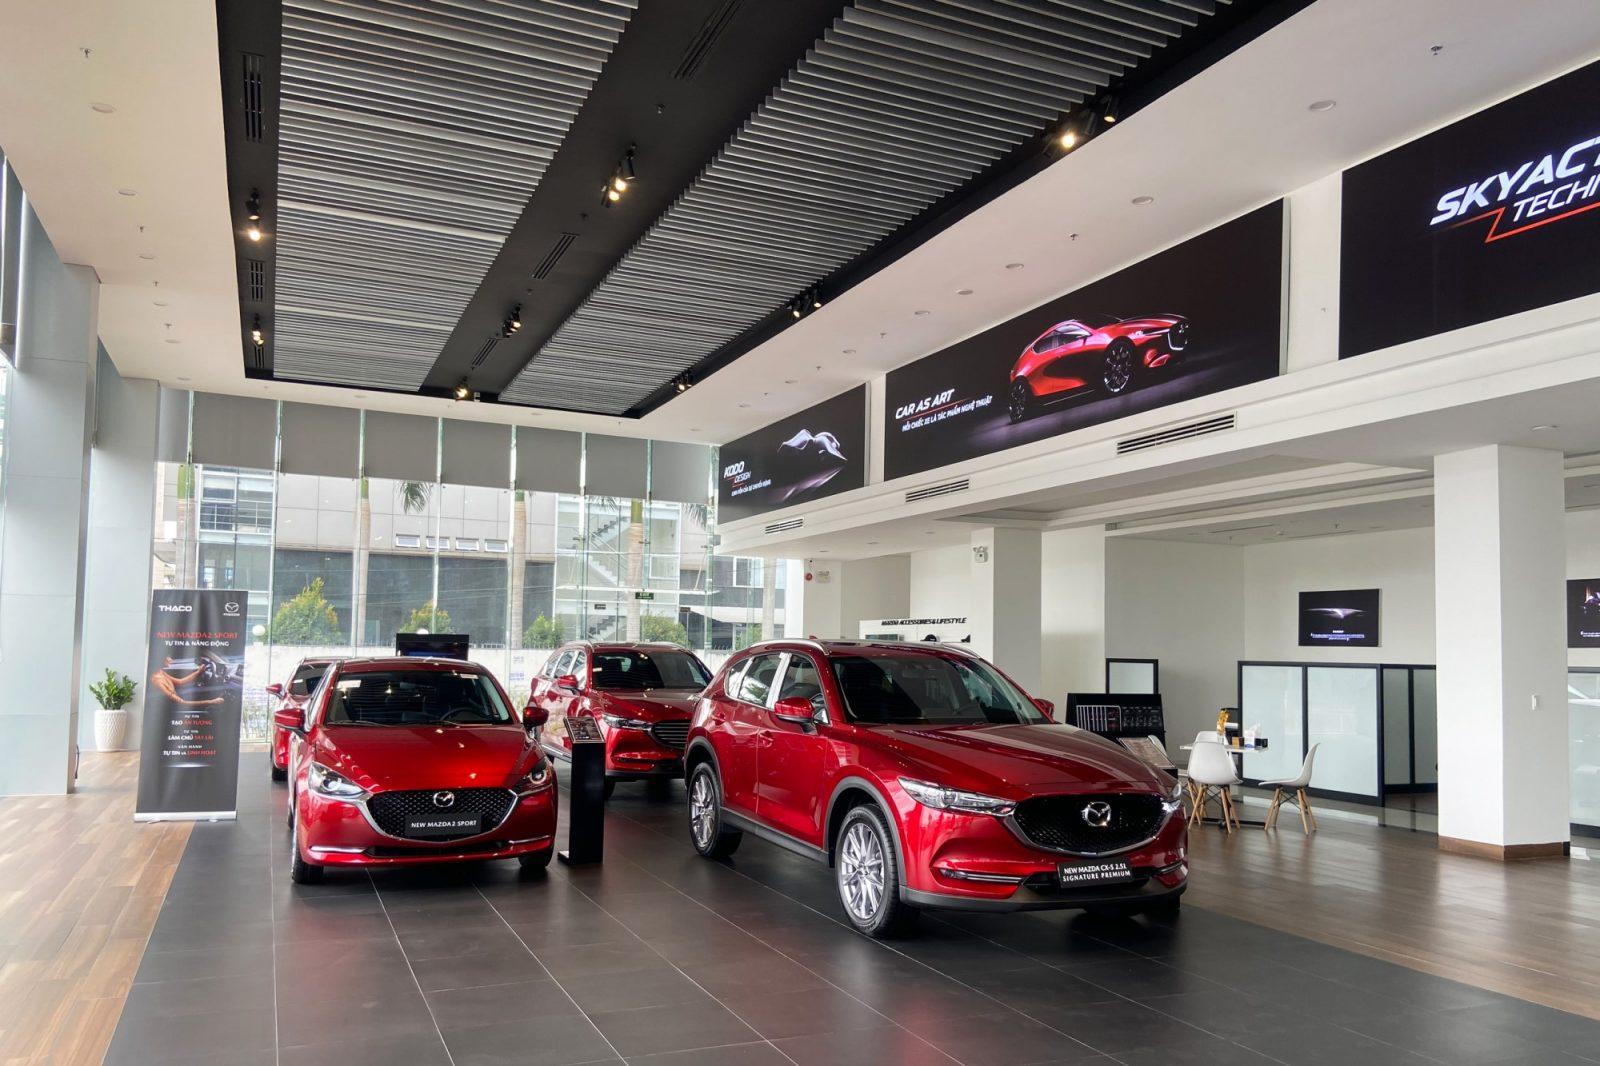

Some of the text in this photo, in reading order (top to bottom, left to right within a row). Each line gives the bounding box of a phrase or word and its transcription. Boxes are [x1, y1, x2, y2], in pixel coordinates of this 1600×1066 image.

[1430, 136, 1600, 225] SKYAC
[895, 388, 955, 419] CAR AS ART
[923, 418, 931, 426] XE
[1078, 865, 1100, 873] MAZDA
[1063, 870, 1131, 882] SIGNATURE PREMIUM
